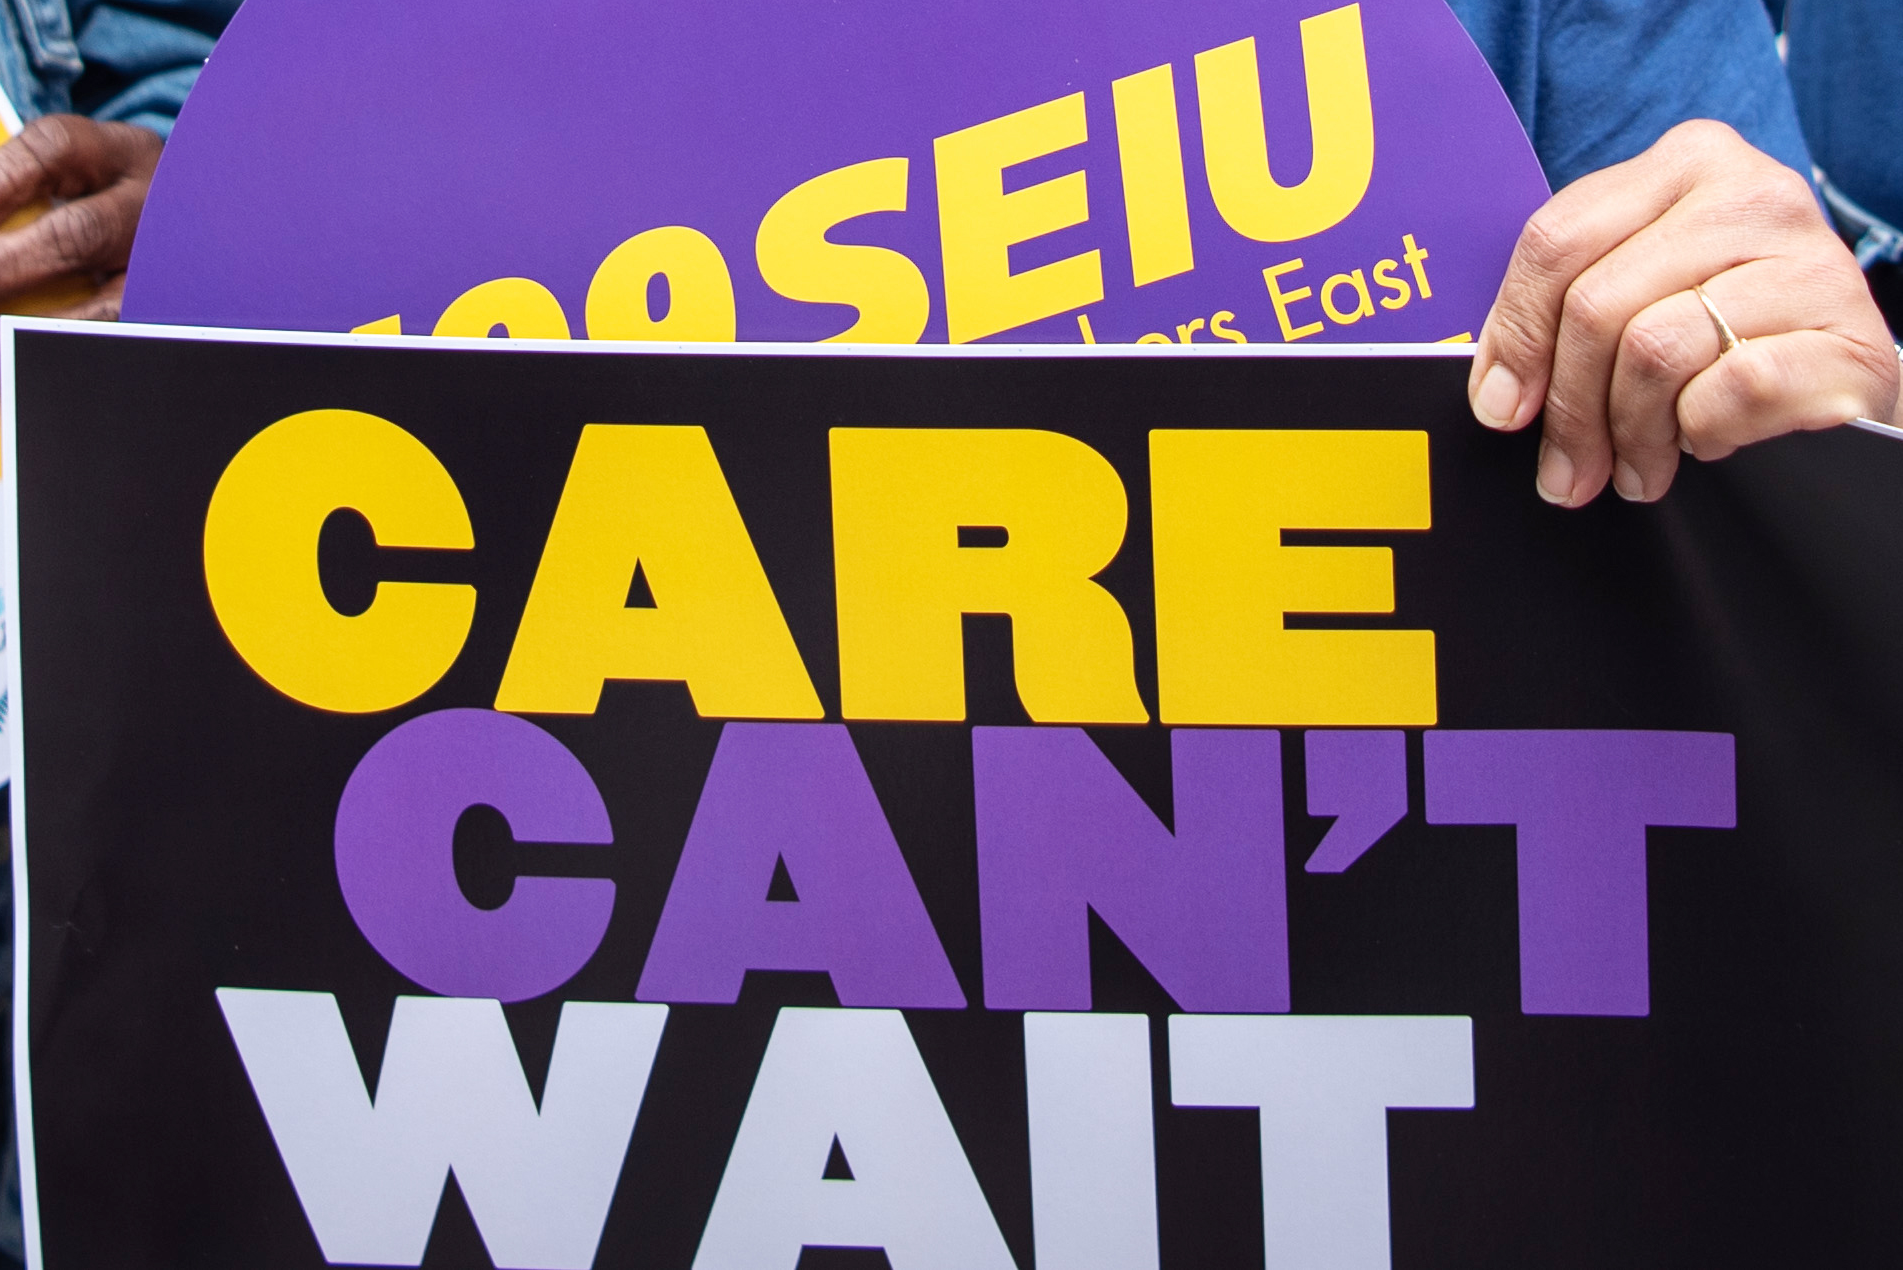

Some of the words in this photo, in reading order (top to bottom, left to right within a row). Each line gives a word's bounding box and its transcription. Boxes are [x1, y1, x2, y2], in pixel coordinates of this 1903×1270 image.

[349, 2, 1375, 344] 9SEIU
[1263, 232, 1434, 344] East
[200, 407, 1440, 730] CARE
[333, 708, 1739, 1017] CAN'T
[213, 987, 1477, 1270] WAIT
